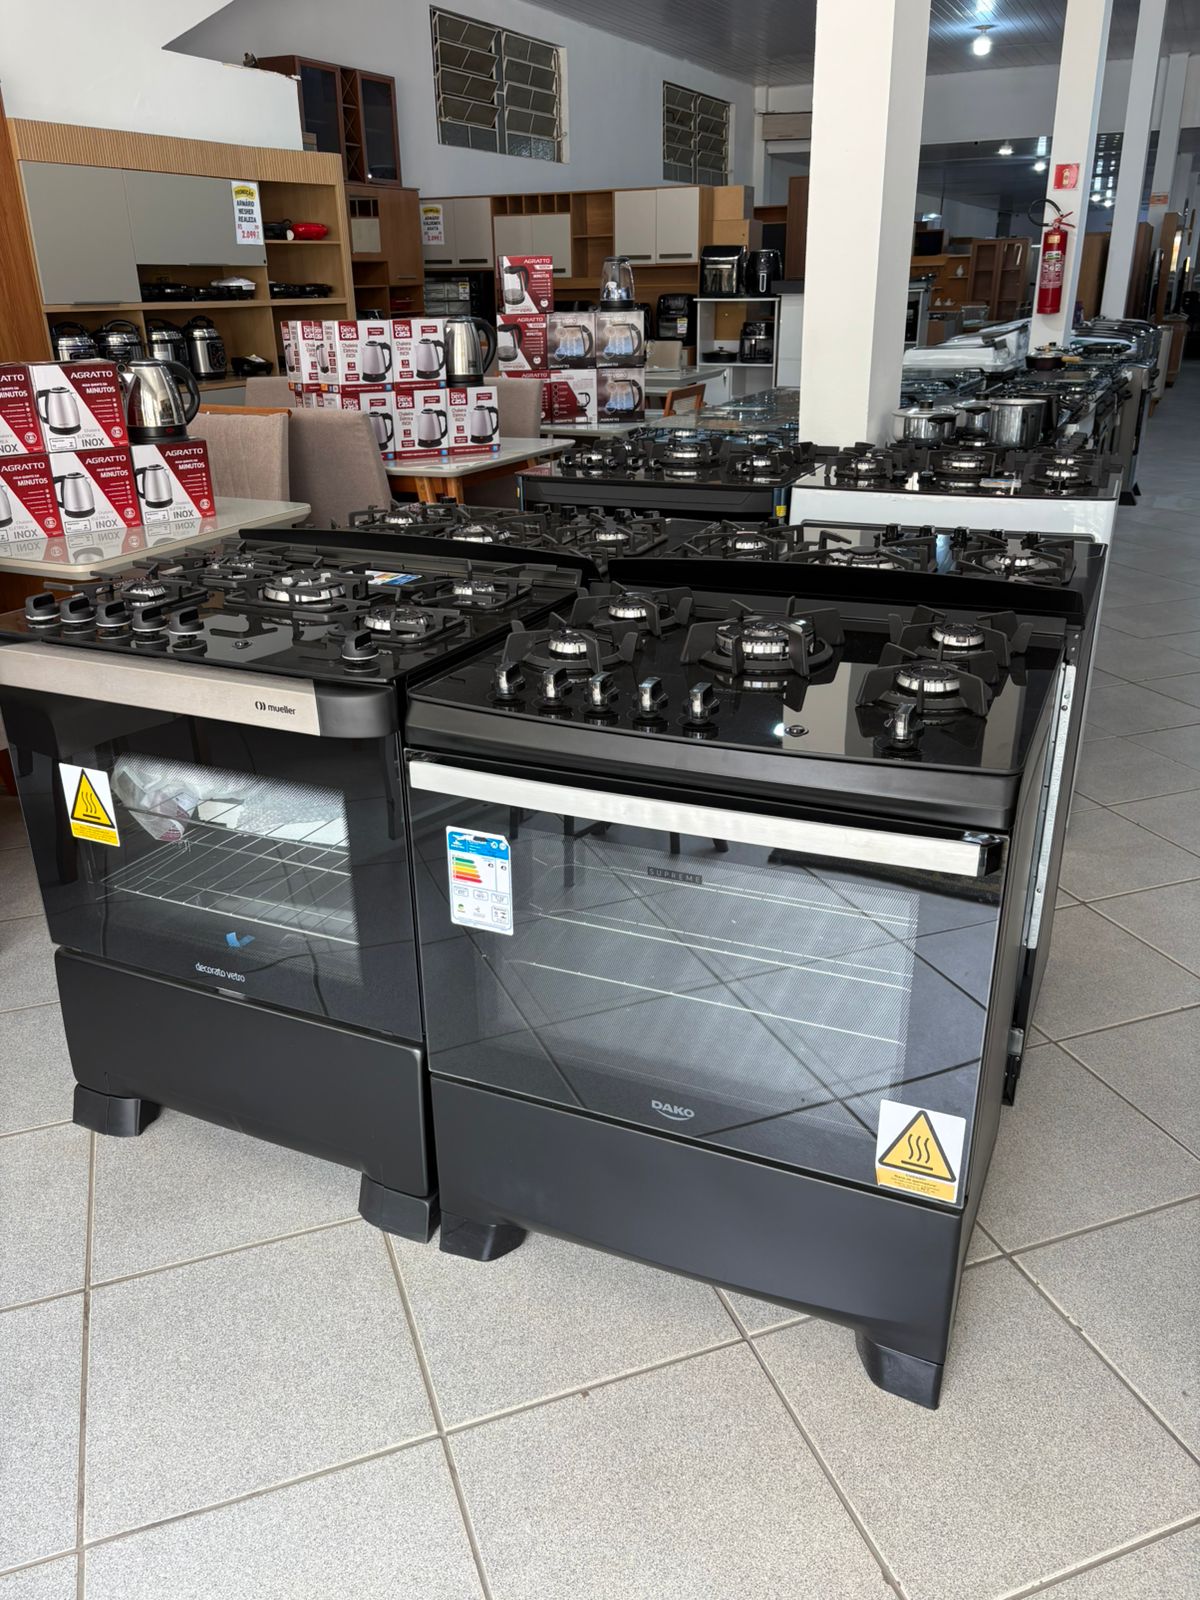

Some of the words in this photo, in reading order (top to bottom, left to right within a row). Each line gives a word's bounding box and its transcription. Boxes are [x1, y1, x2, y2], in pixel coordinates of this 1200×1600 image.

[0, 374, 24, 382] ATTO
[70, 370, 113, 379] AGRATTO
[82, 438, 105, 447] INOX
[0, 444, 19, 454] NOX
[165, 448, 203, 457] AGRATTO
[86, 454, 126, 465] AGRATTO
[1, 462, 45, 472] AGRATTO
[178, 462, 205, 470] MINUTOS
[100, 470, 128, 478] MINUTOS
[18, 477, 48, 486] MINUTOS
[173, 510, 194, 519] INOX
[95, 519, 118, 528] INOX
[14, 529, 38, 539] INOX
[268, 705, 296, 715] mueller
[649, 868, 700, 884] SUPREME
[195, 962, 226, 977] decorato
[226, 971, 246, 982] vetro
[652, 1100, 695, 1118] DAKO
